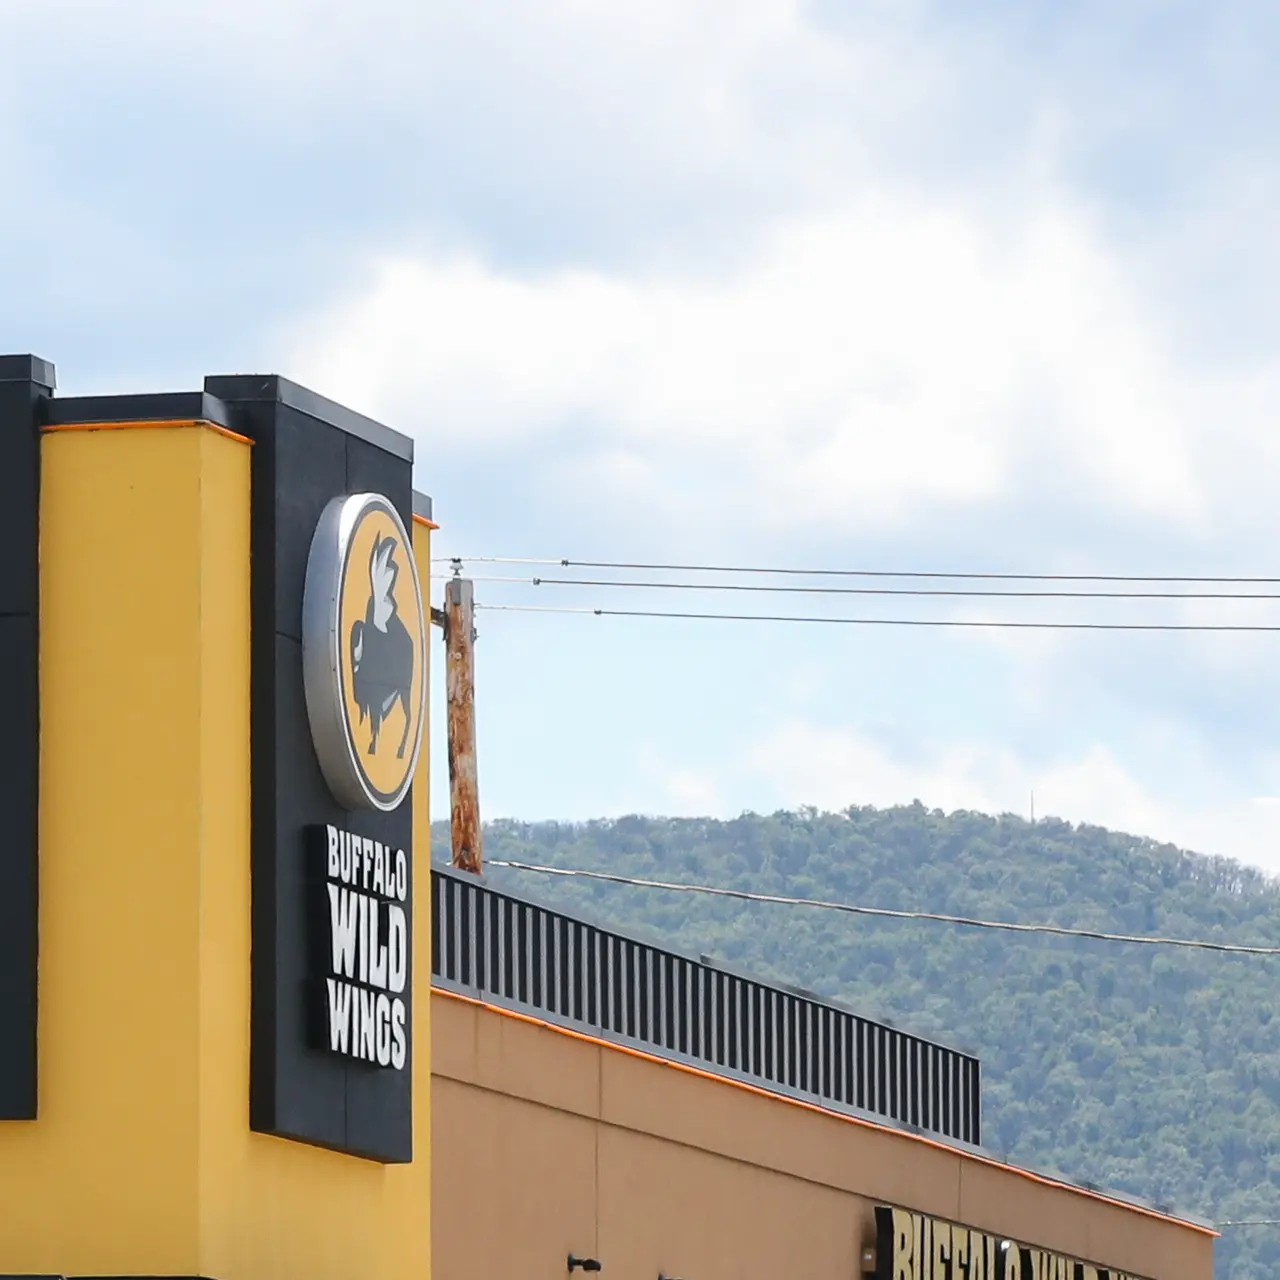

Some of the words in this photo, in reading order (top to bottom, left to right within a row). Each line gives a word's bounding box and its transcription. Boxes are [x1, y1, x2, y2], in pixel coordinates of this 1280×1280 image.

[326, 823, 407, 902] BUFFALO
[326, 882, 407, 993] WILD
[326, 977, 407, 1071] WINGS
